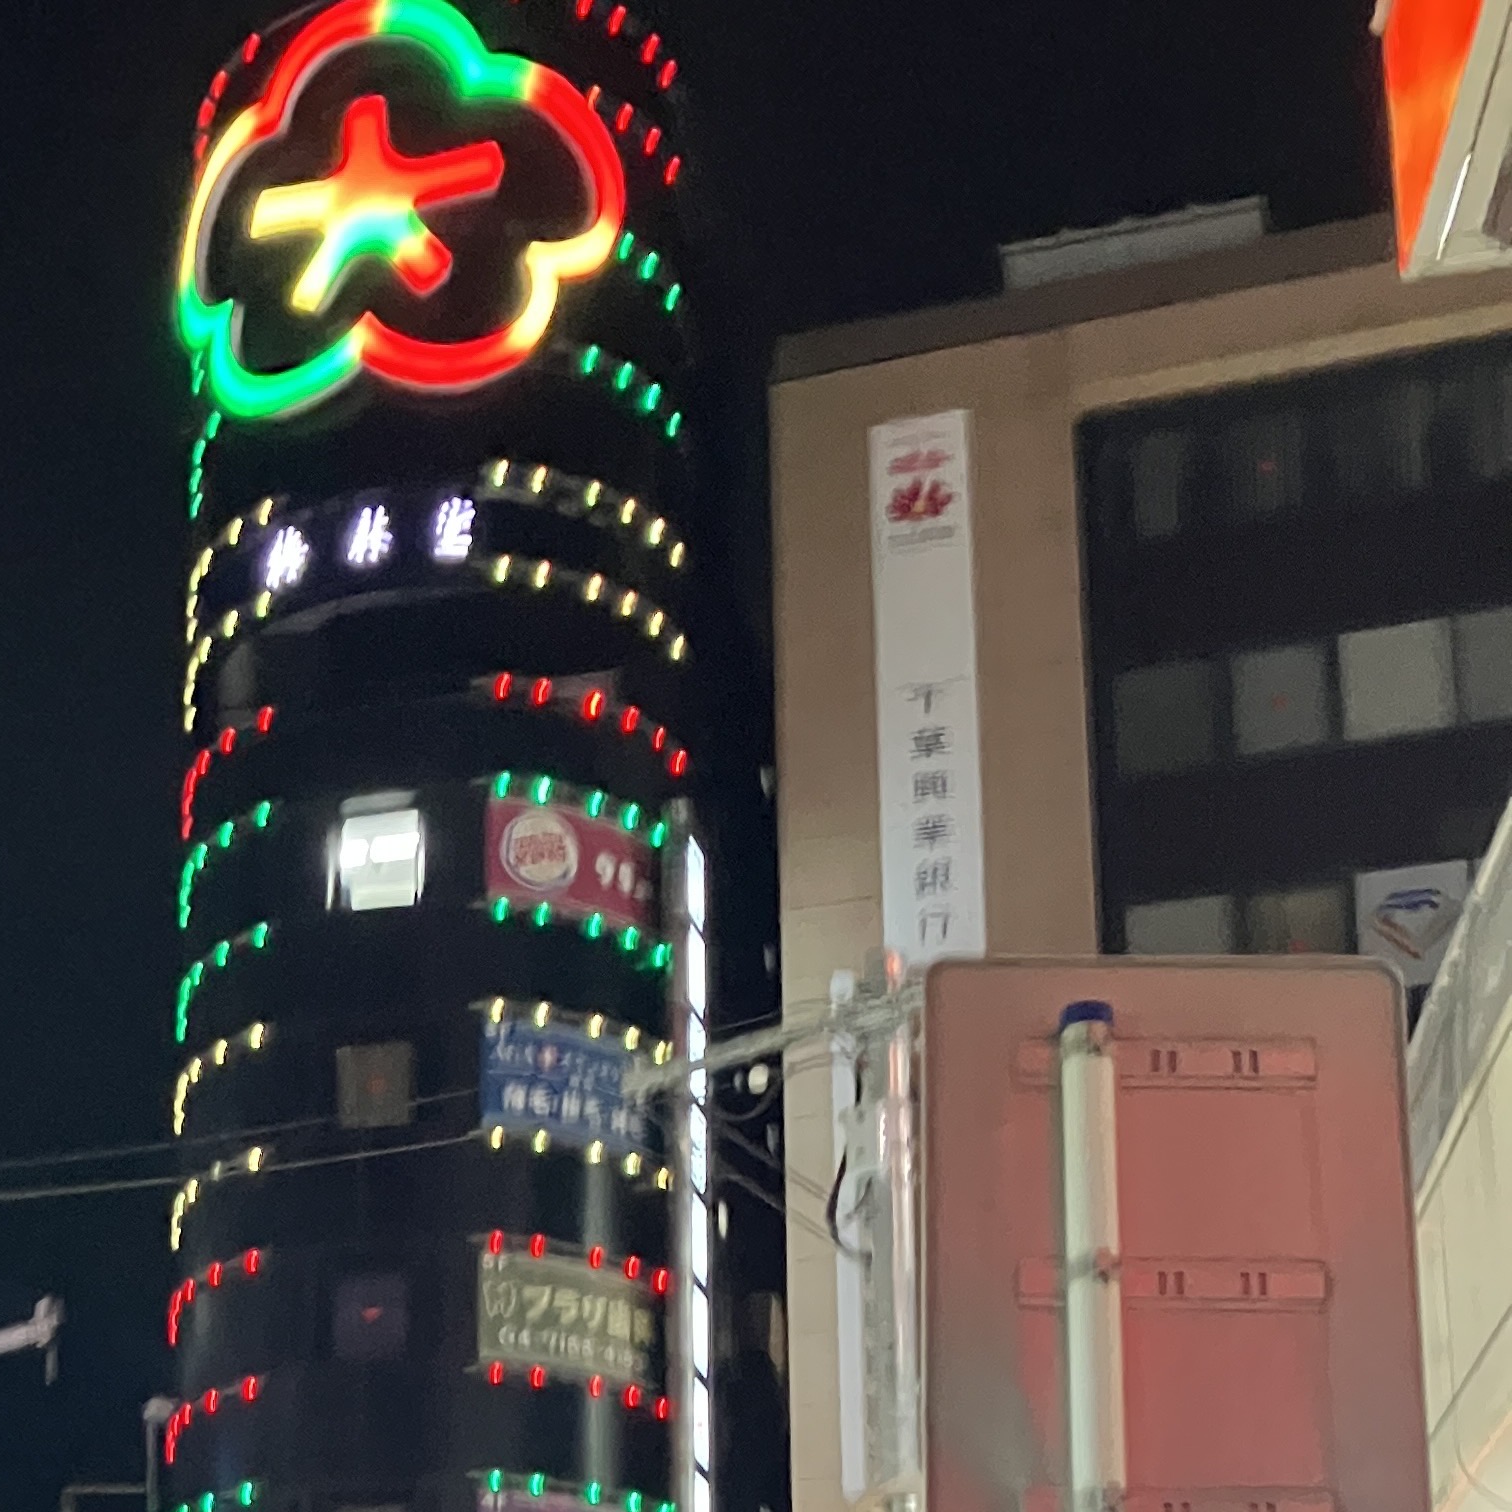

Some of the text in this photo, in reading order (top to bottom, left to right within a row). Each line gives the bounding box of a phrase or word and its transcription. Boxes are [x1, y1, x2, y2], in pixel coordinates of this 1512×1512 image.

[907, 682, 956, 948] 千葉興業銀行
